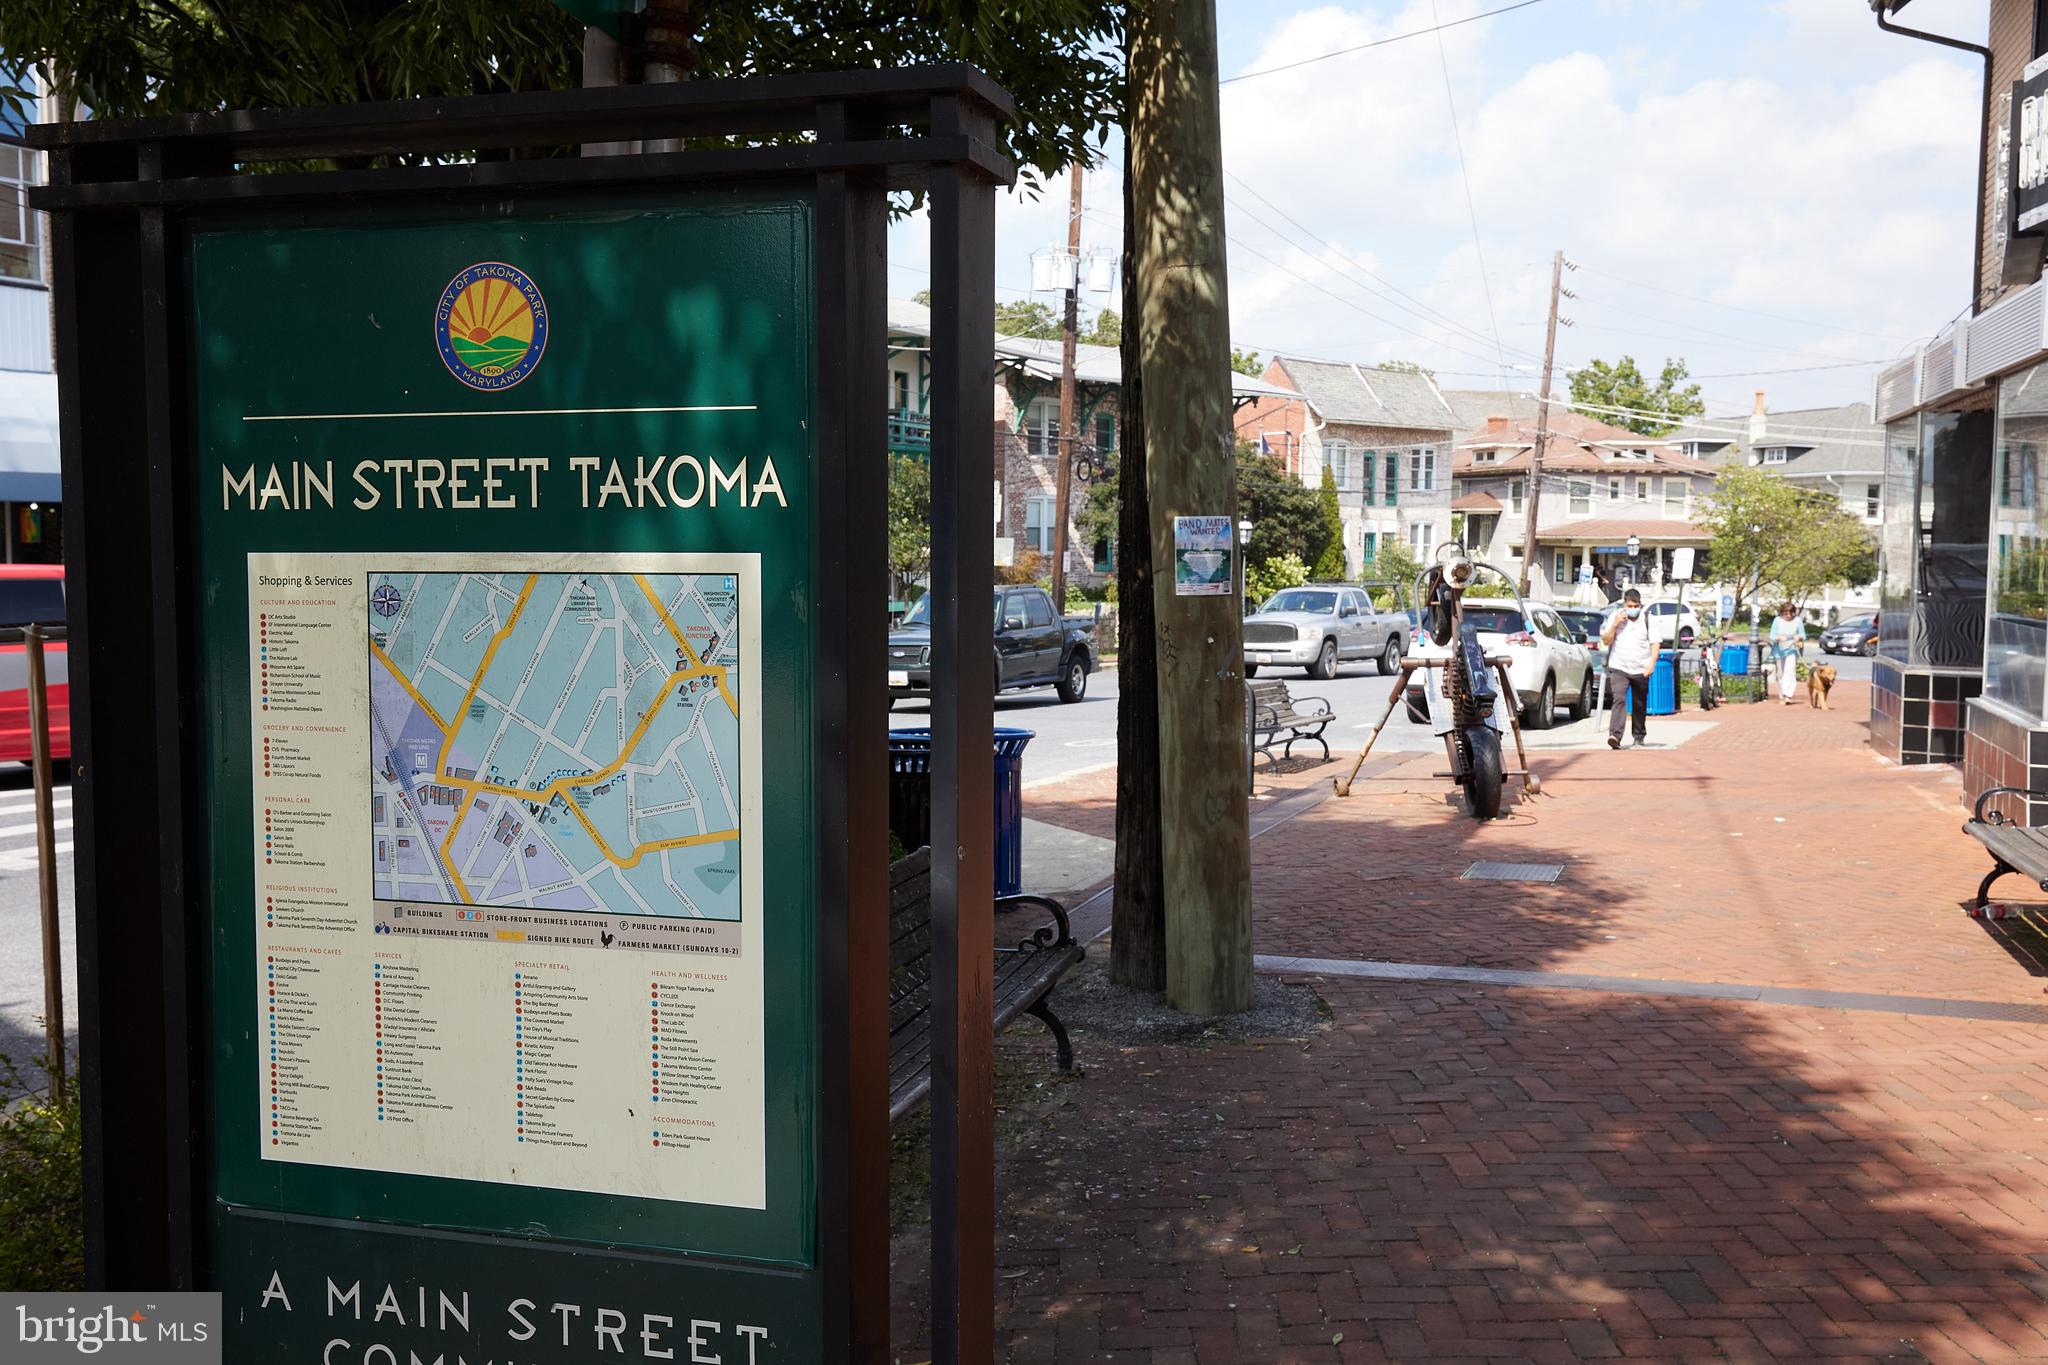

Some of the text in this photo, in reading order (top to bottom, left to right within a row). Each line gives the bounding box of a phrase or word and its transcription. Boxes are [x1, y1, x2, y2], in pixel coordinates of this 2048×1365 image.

[440, 266, 544, 320] CITY OF TAKOMA PARK
[463, 370, 520, 387] MARYLAND
[222, 454, 788, 511] MAIN STREET TAKOMA
[1178, 518, 1229, 529] BAND MATES
[259, 576, 352, 588] Shopping & Services
[465, 615, 495, 640] BARCLAY AVENUE
[689, 695, 708, 738] COLUMBIA AVENUE
[674, 761, 695, 799] HICKORY AVENUE
[642, 806, 673, 814] MONTGOMERY
[453, 816, 462, 830] STREET
[570, 803, 594, 834] WESTMORELAND
[594, 834, 606, 850] AVENUE
[487, 914, 531, 923] STORE-FRONT
[683, 945, 719, 953] (SUNDAYS
[653, 1116, 715, 1127] ACCOMMODATIONS
[262, 1270, 292, 1312] A
[326, 1275, 470, 1332] MAIN
[508, 1299, 772, 1361] STREET
